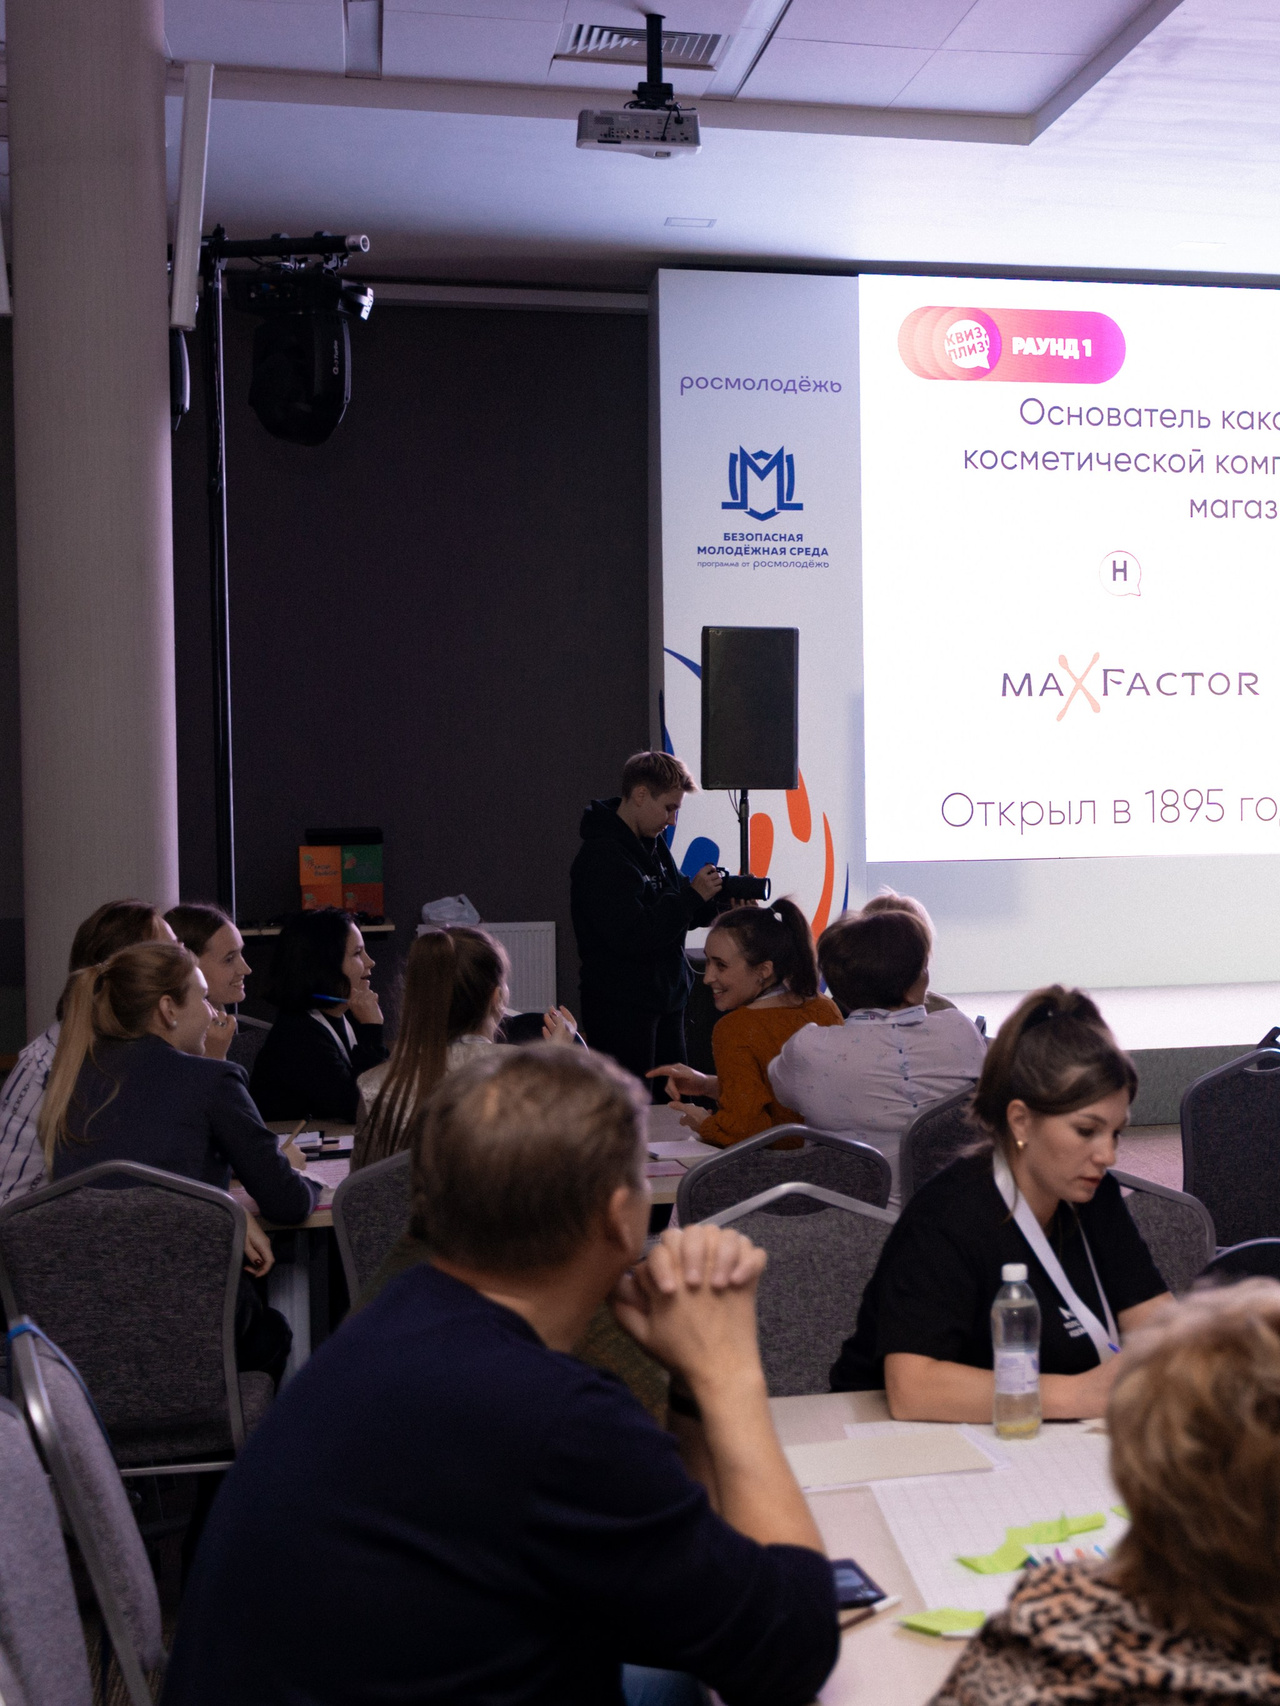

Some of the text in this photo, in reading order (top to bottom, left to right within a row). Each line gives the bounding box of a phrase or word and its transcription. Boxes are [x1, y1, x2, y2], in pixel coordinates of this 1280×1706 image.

[1012, 337, 1092, 359] РАУНД 1
[681, 375, 842, 396] росмолодёжь
[1020, 398, 1211, 429] Основатель
[964, 449, 1204, 473] косметической
[723, 532, 804, 542] БЕЗОПАСНАЯ
[697, 544, 829, 557] МОЛОДЁЖНАЯ СРЕДА
[753, 560, 830, 570] росмолодёжь
[941, 792, 1096, 835] Открыл
[1113, 800, 1131, 825] в
[1145, 789, 1225, 823] 1895
